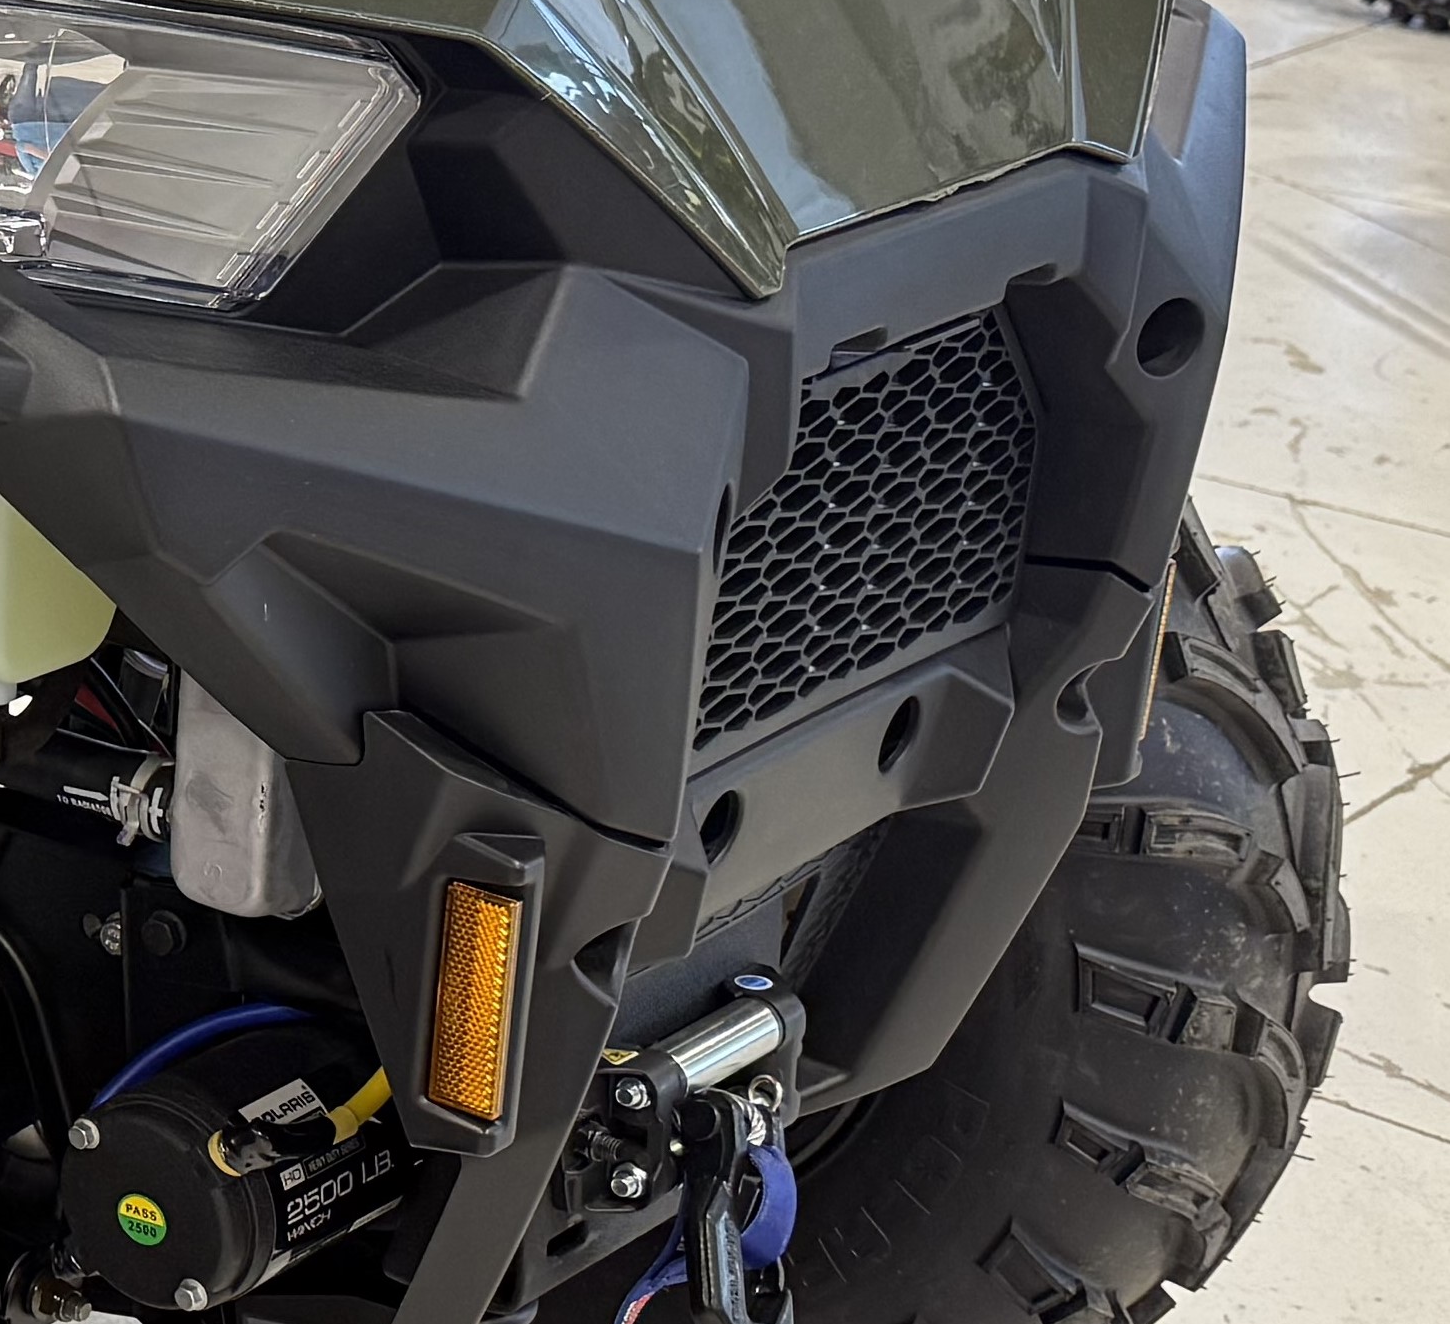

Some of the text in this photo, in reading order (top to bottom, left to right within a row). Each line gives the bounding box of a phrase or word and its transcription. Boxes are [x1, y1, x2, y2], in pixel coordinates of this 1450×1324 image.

[286, 1170, 354, 1226] 2500
[125, 1202, 157, 1222] PASS
[127, 1220, 157, 1238] 2500
